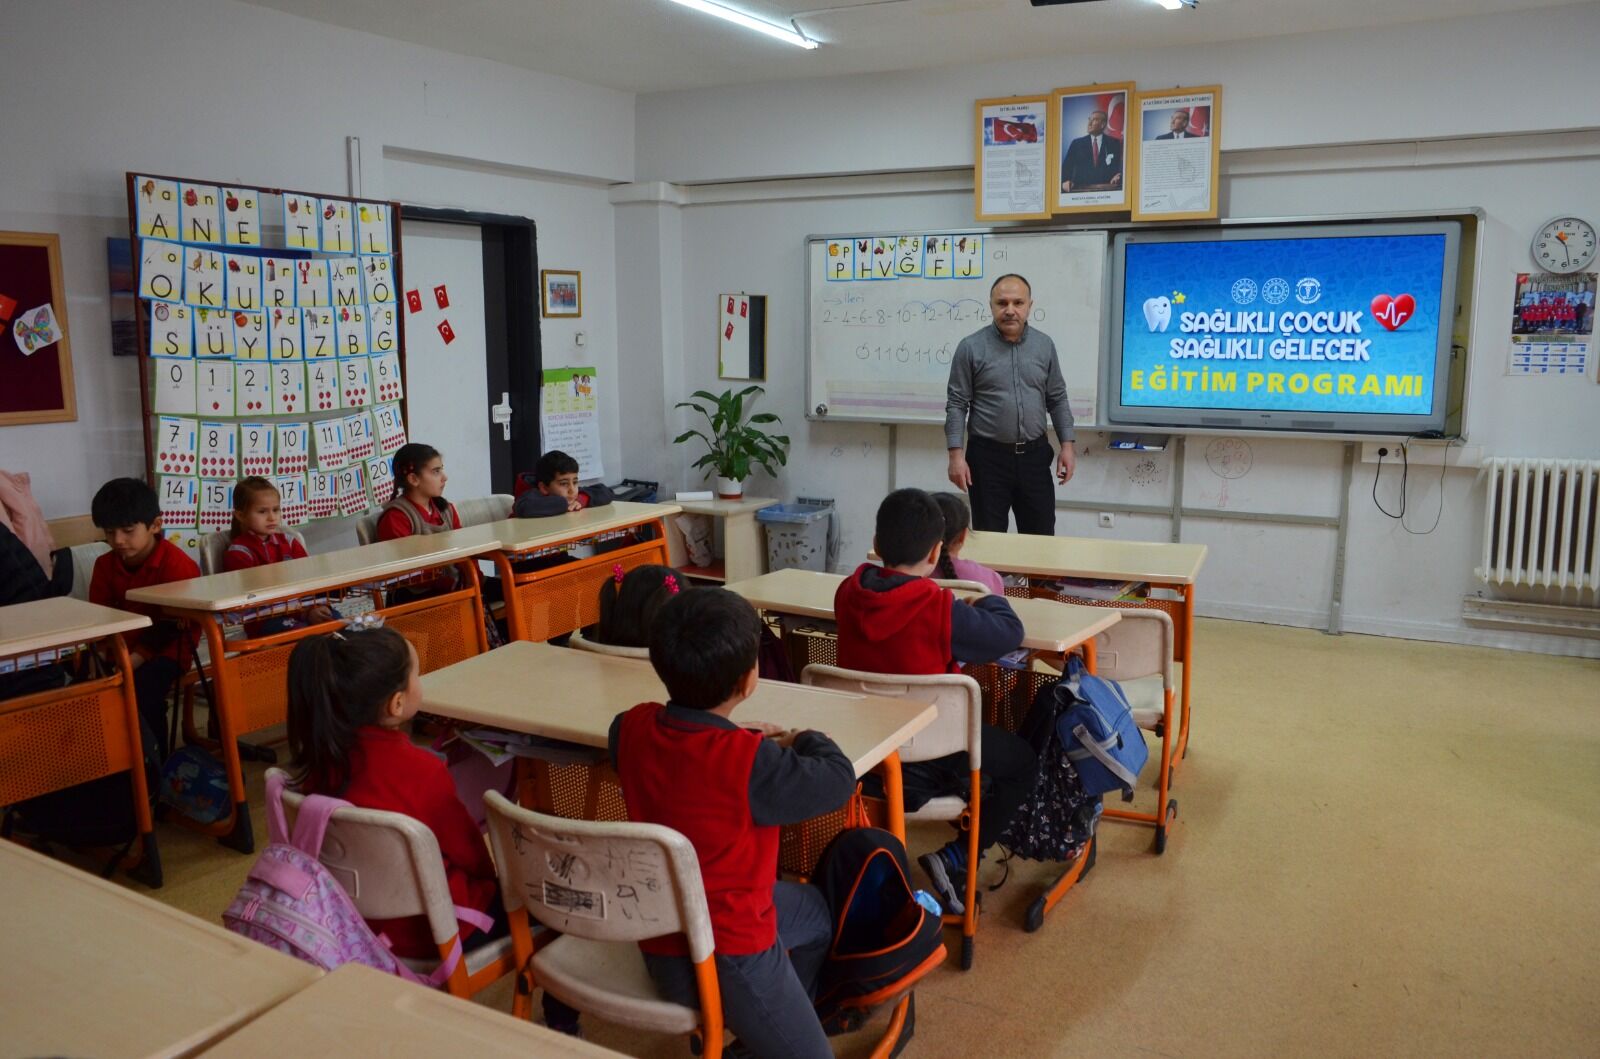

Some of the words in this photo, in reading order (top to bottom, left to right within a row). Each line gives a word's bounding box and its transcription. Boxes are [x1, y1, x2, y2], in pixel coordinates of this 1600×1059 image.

[162, 191, 170, 200] a
[205, 196, 213, 205] n
[245, 200, 252, 208] e
[306, 200, 311, 214] t
[150, 214, 168, 238] A
[193, 218, 210, 242] N
[238, 222, 250, 244] E
[297, 226, 308, 247] T
[370, 233, 380, 253] L
[844, 247, 849, 258] p
[942, 238, 948, 251] f
[168, 253, 176, 262] o
[210, 252, 217, 270] k
[247, 266, 254, 274] u
[283, 268, 289, 276] r
[380, 259, 386, 270] ö
[837, 263, 844, 278] P
[879, 261, 891, 277] V
[900, 252, 914, 273] Ğ
[934, 260, 944, 276] F
[963, 260, 971, 276] J
[151, 274, 172, 298] O
[200, 282, 213, 305] K
[237, 287, 251, 309] U
[275, 289, 284, 307] R
[338, 288, 355, 306] M
[374, 276, 388, 302] Ö
[178, 310, 184, 318] s
[254, 316, 262, 331] y
[288, 310, 294, 325] d
[322, 316, 328, 324] z
[354, 307, 361, 322] b
[876, 309, 885, 324] 8
[1180, 309, 1274, 333] SAĞLIKLI
[1280, 311, 1363, 336] ÇOCUK
[166, 332, 178, 354] S
[208, 326, 224, 354] Ü
[243, 337, 257, 358] Y
[281, 338, 294, 358] D
[315, 336, 326, 356] Z
[348, 335, 358, 354] B
[378, 331, 392, 350] G
[1169, 335, 1263, 360] SAĞLIKLI
[1269, 339, 1372, 361] GELECEK
[171, 365, 182, 382] 0
[245, 370, 255, 386] 2
[281, 369, 289, 385] 3
[316, 368, 324, 383] 4
[348, 365, 356, 380] 5
[380, 361, 386, 375] 6
[1131, 365, 1236, 393] EĞİTİM
[1246, 372, 1423, 396] PROGRAMI
[170, 425, 179, 442] 7
[209, 431, 218, 447] 8
[250, 431, 258, 447] 9
[283, 431, 296, 447] 10
[322, 427, 333, 443] 11
[349, 420, 362, 438] 12
[380, 412, 392, 428] 13
[167, 481, 184, 498] 14
[208, 486, 224, 503] 15
[281, 482, 293, 499] 17
[314, 475, 325, 491] 18
[340, 473, 351, 490] 19
[371, 461, 387, 479] 20
[188, 539, 196, 548] c
